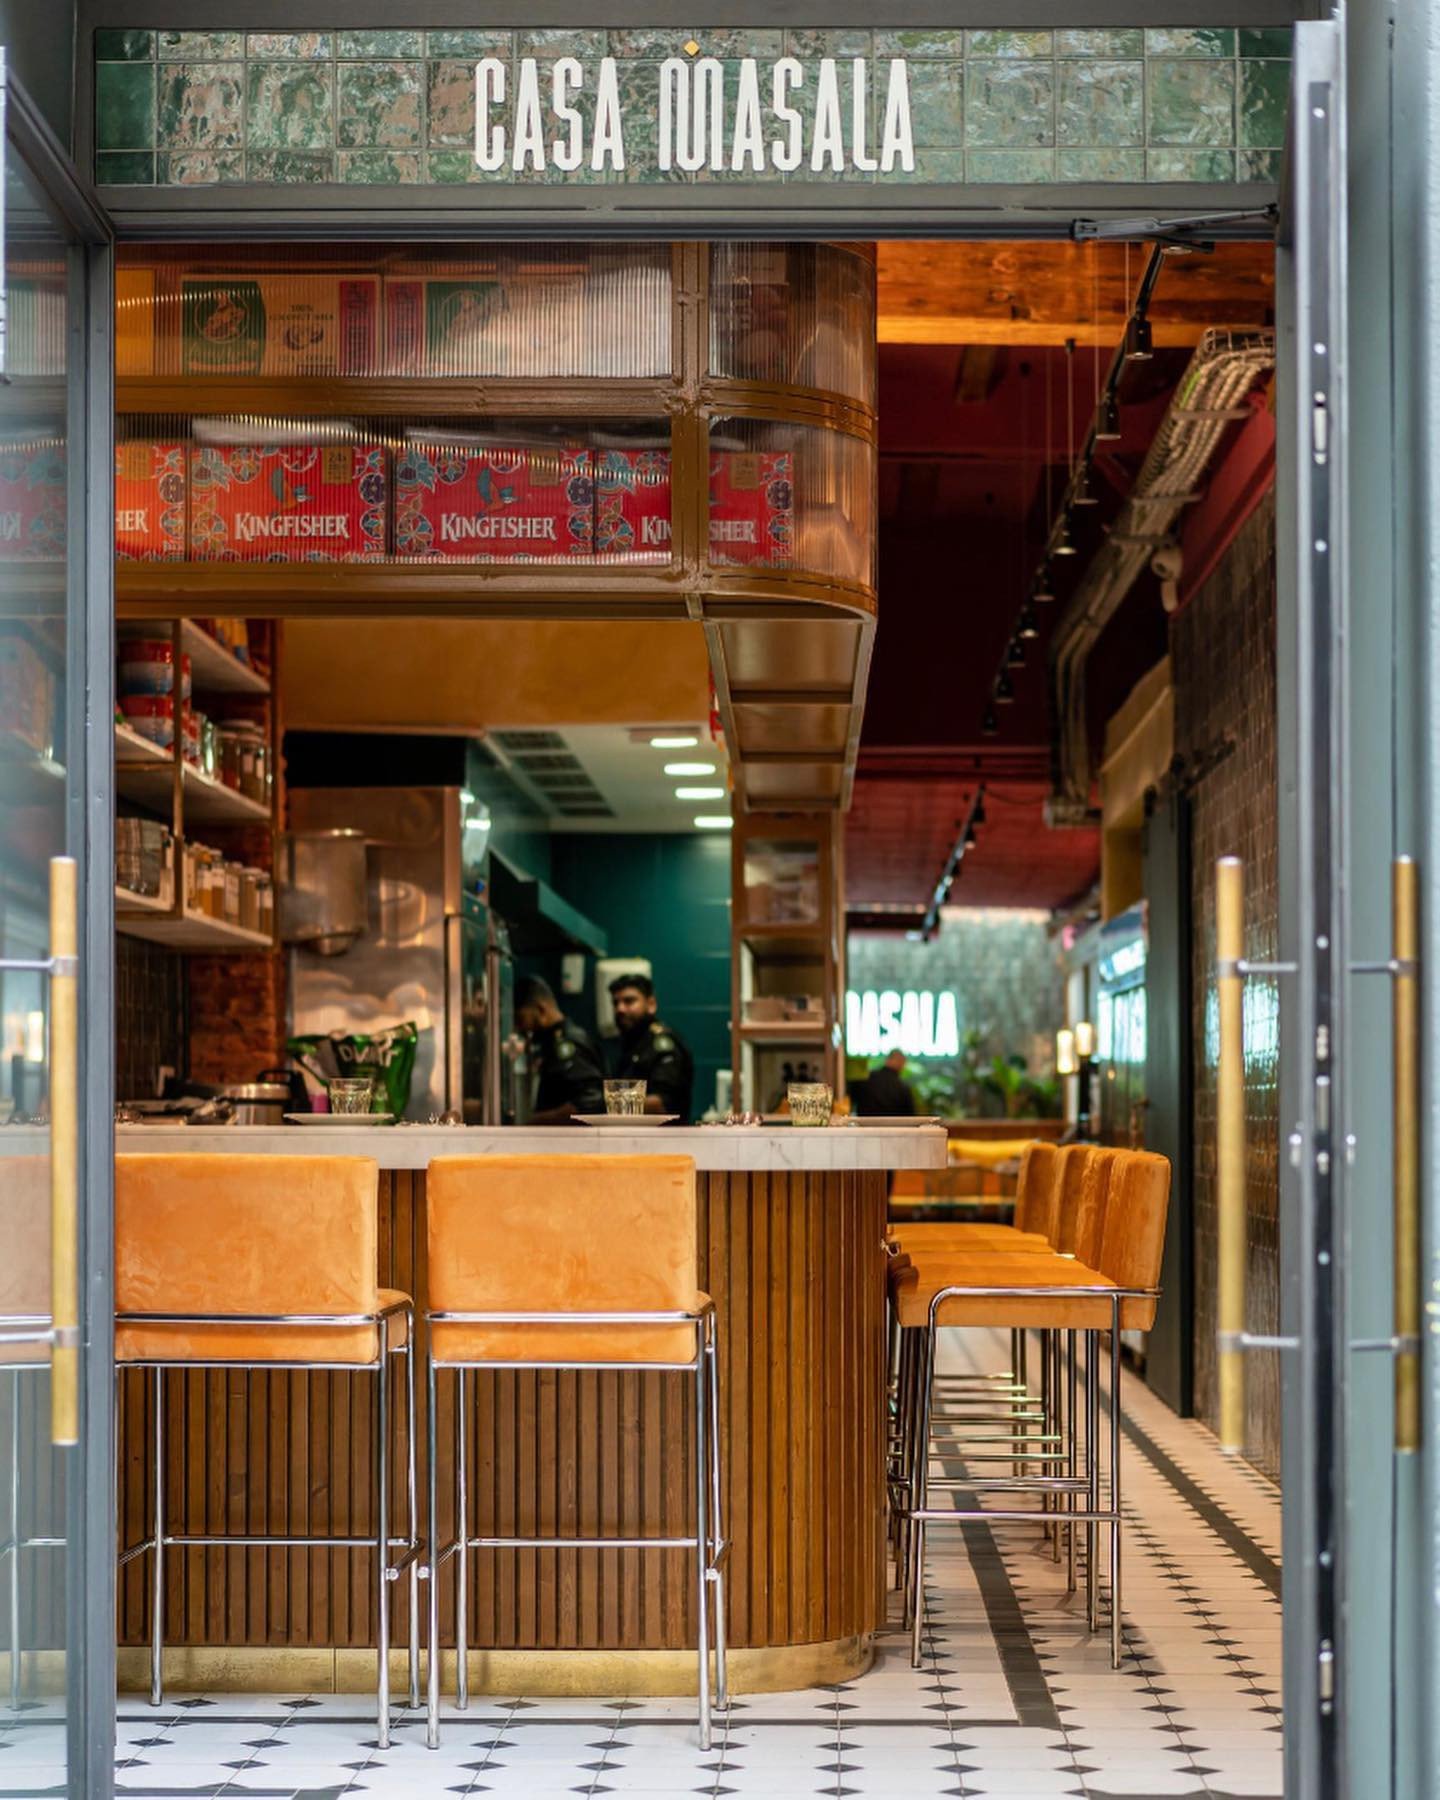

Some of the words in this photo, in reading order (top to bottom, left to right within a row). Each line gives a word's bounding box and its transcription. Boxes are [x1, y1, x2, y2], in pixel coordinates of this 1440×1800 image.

[475, 57, 625, 172] CASA
[658, 57, 915, 172] MASALA
[234, 511, 350, 542] KINGFISHER
[440, 512, 558, 543] KINGFISHER
